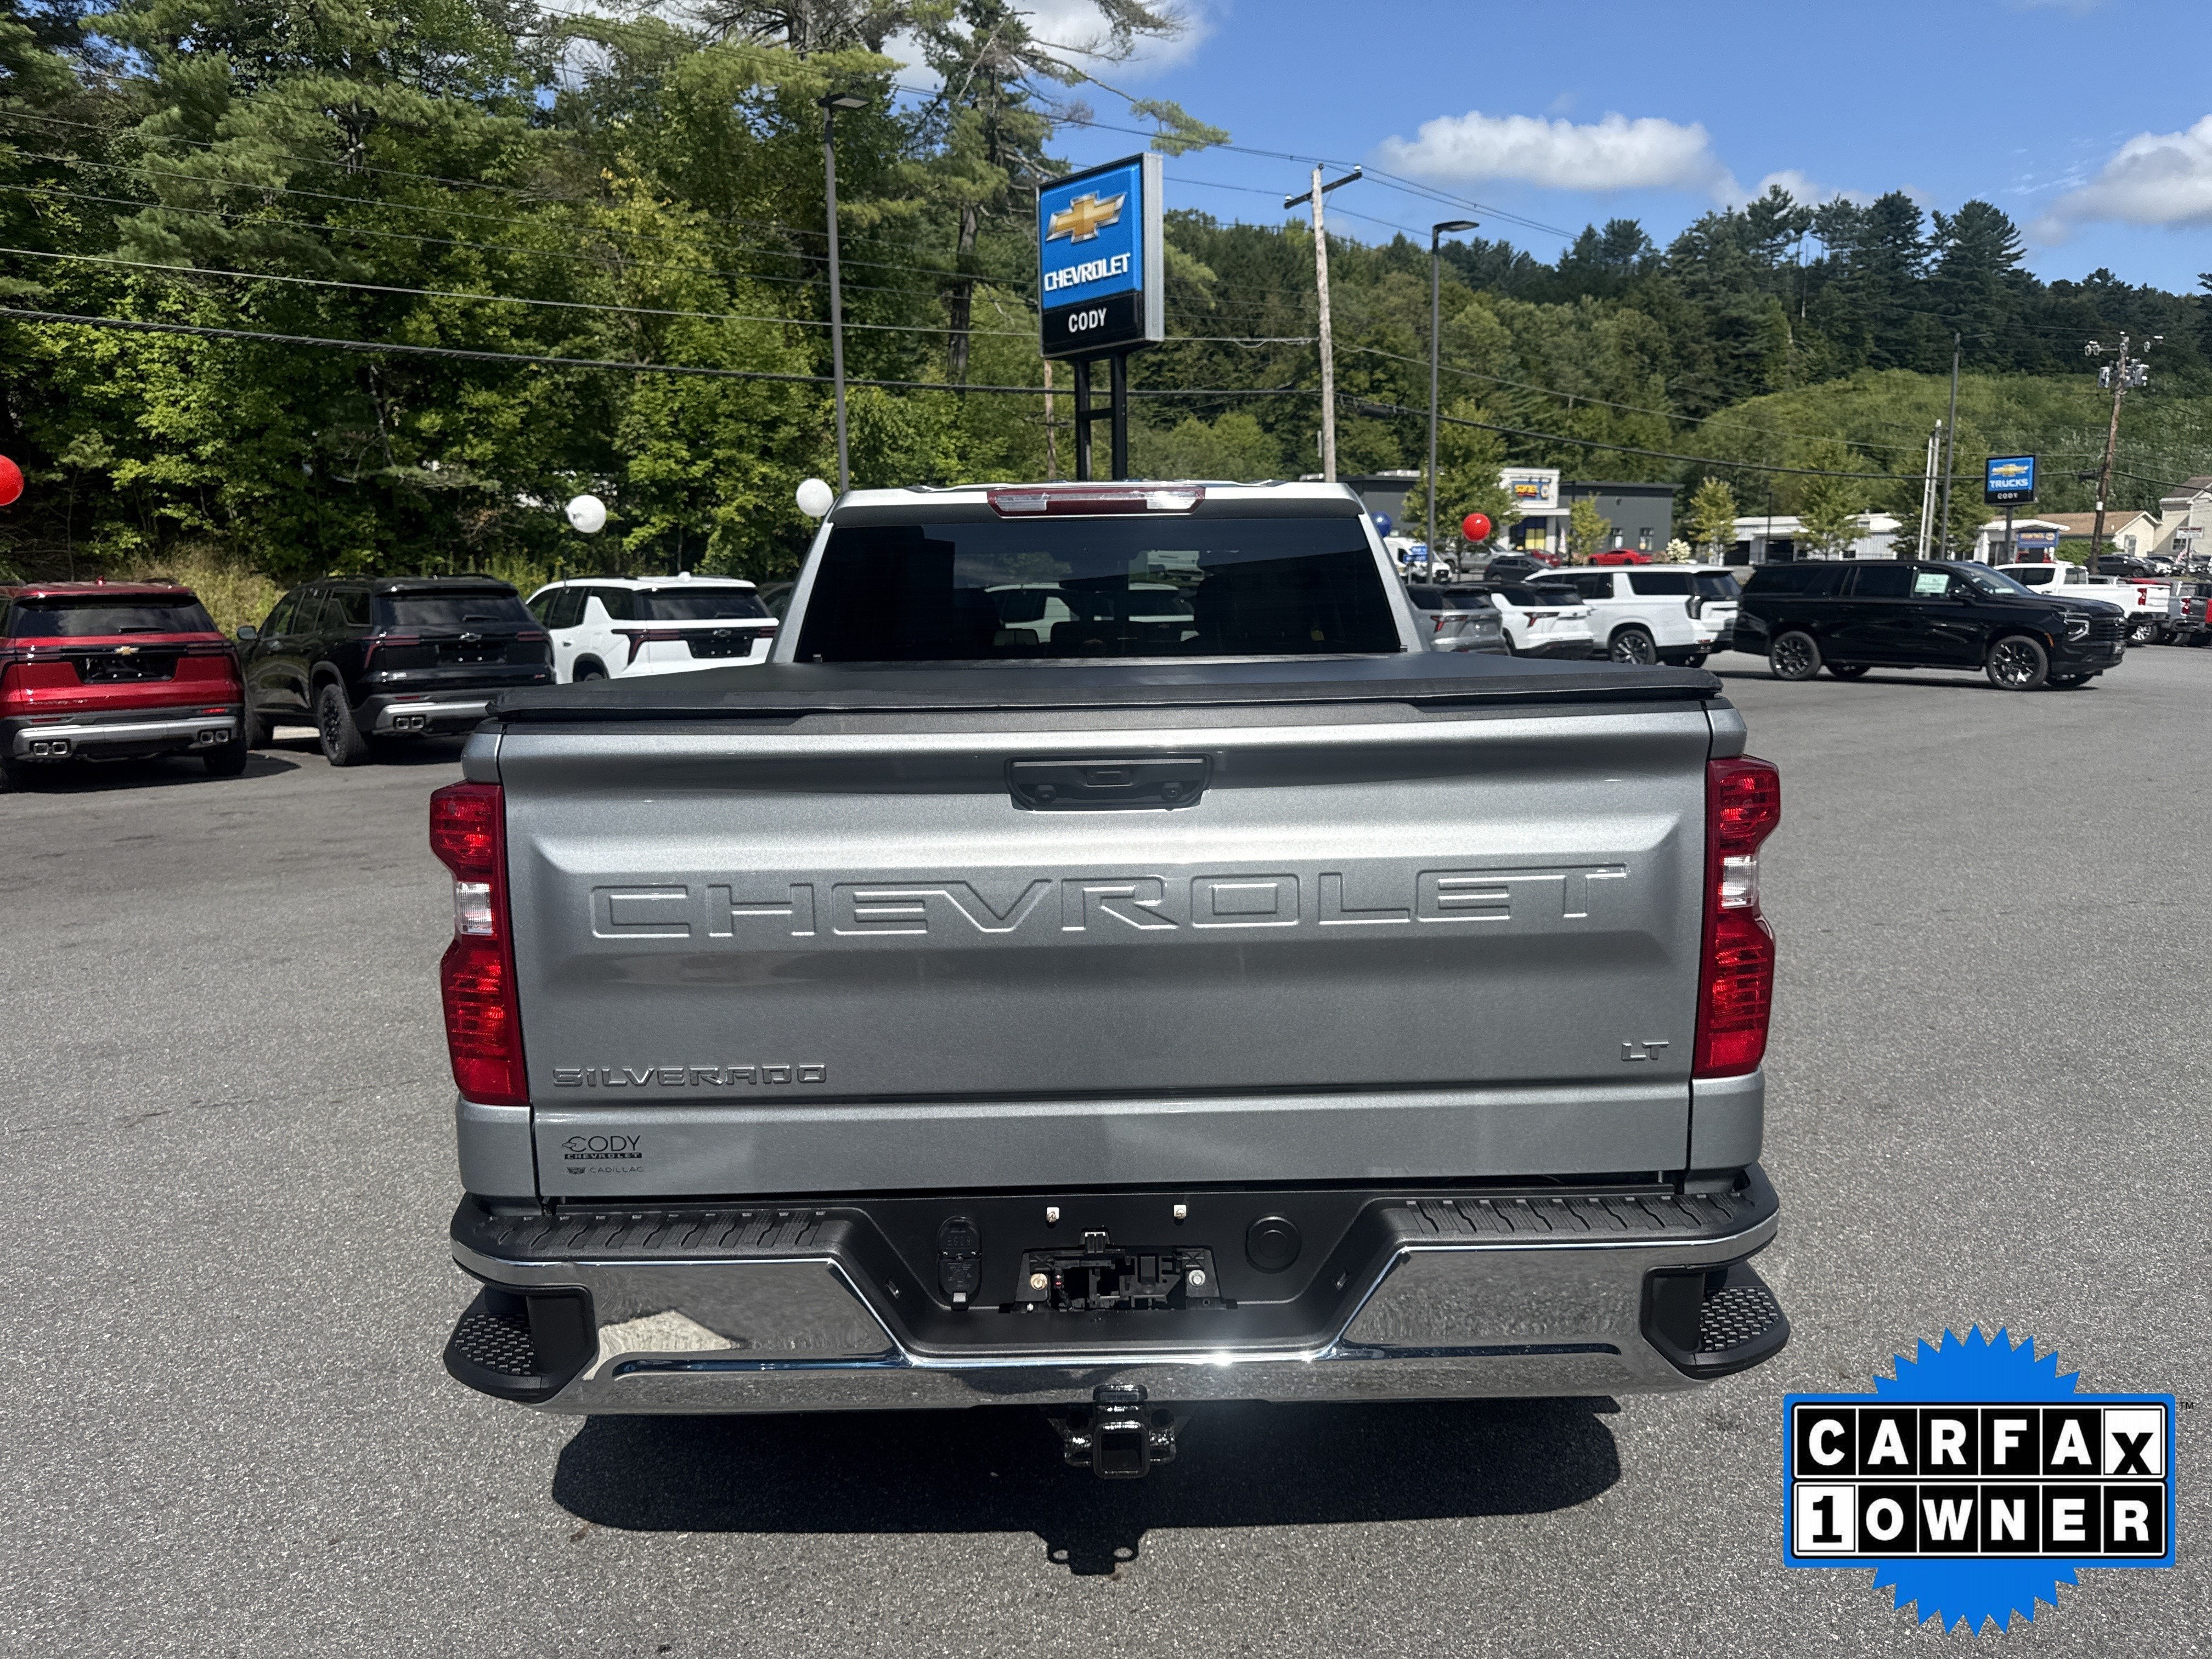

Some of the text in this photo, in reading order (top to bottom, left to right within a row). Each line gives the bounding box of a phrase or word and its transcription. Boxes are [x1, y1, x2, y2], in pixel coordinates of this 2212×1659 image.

[1044, 252, 1131, 291] CHEVROLET
[1068, 308, 1107, 333] CODY
[1989, 478, 2028, 488] TRUCKS
[591, 864, 1627, 939] CHEVROLET
[1621, 1040, 1669, 1062] LT
[553, 1063, 827, 1087] SILVERADO
[565, 1135, 641, 1152] CODY
